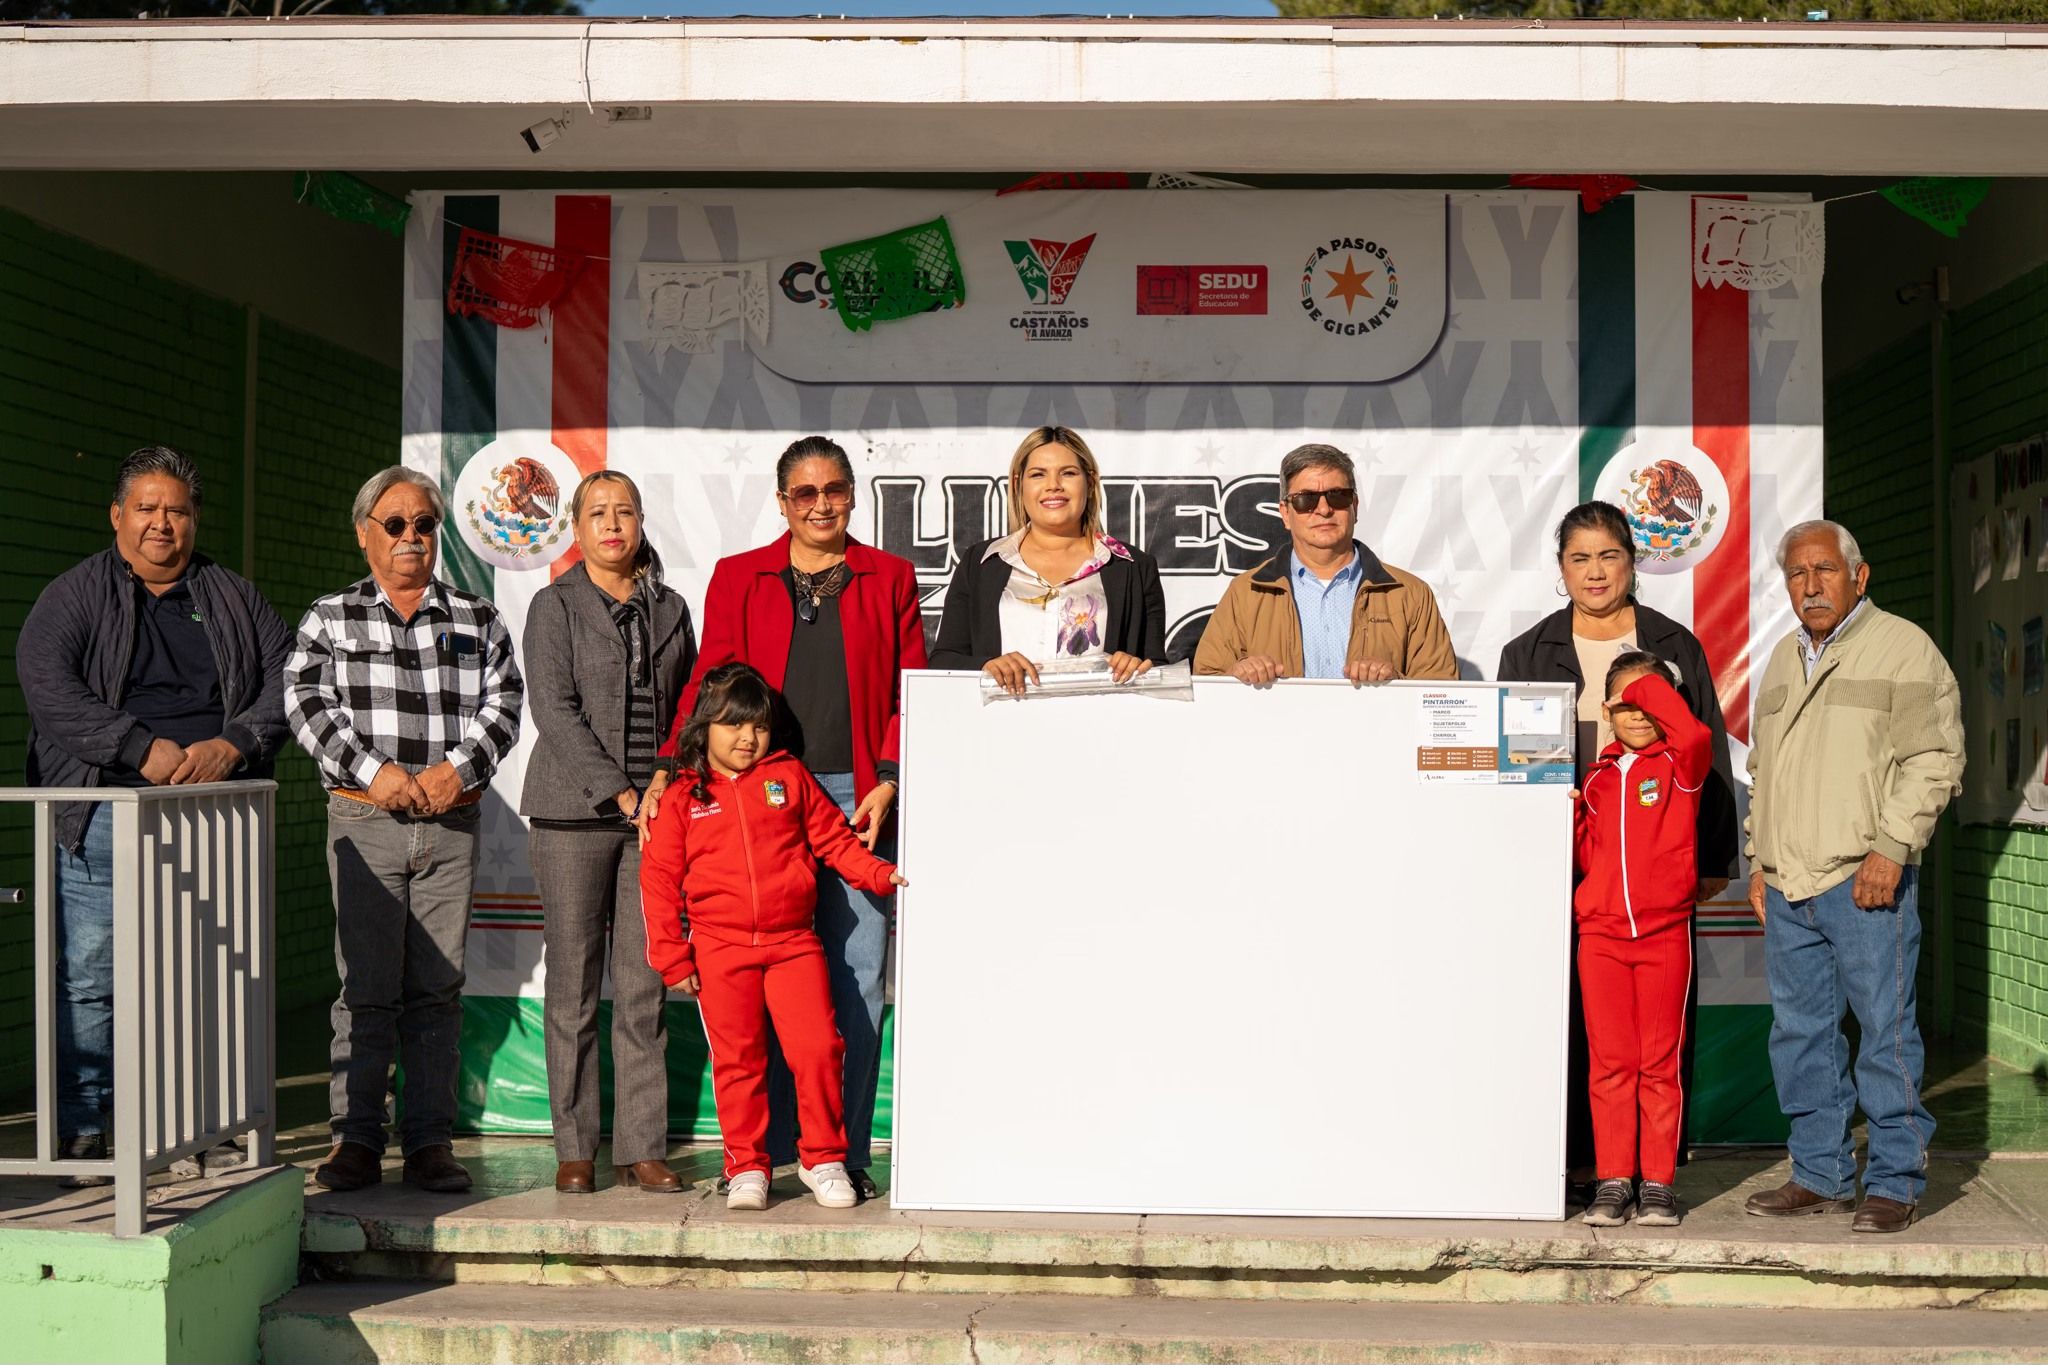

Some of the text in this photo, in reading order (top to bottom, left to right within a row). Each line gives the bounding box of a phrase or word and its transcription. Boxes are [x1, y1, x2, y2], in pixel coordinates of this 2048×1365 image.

[1316, 237, 1388, 260] A PASOS
[1199, 273, 1258, 289] SEDU
[1010, 314, 1089, 329] CASTAÑOS
[1301, 296, 1399, 336] DE GIGANTE
[1024, 329, 1073, 338] YA AVANZA
